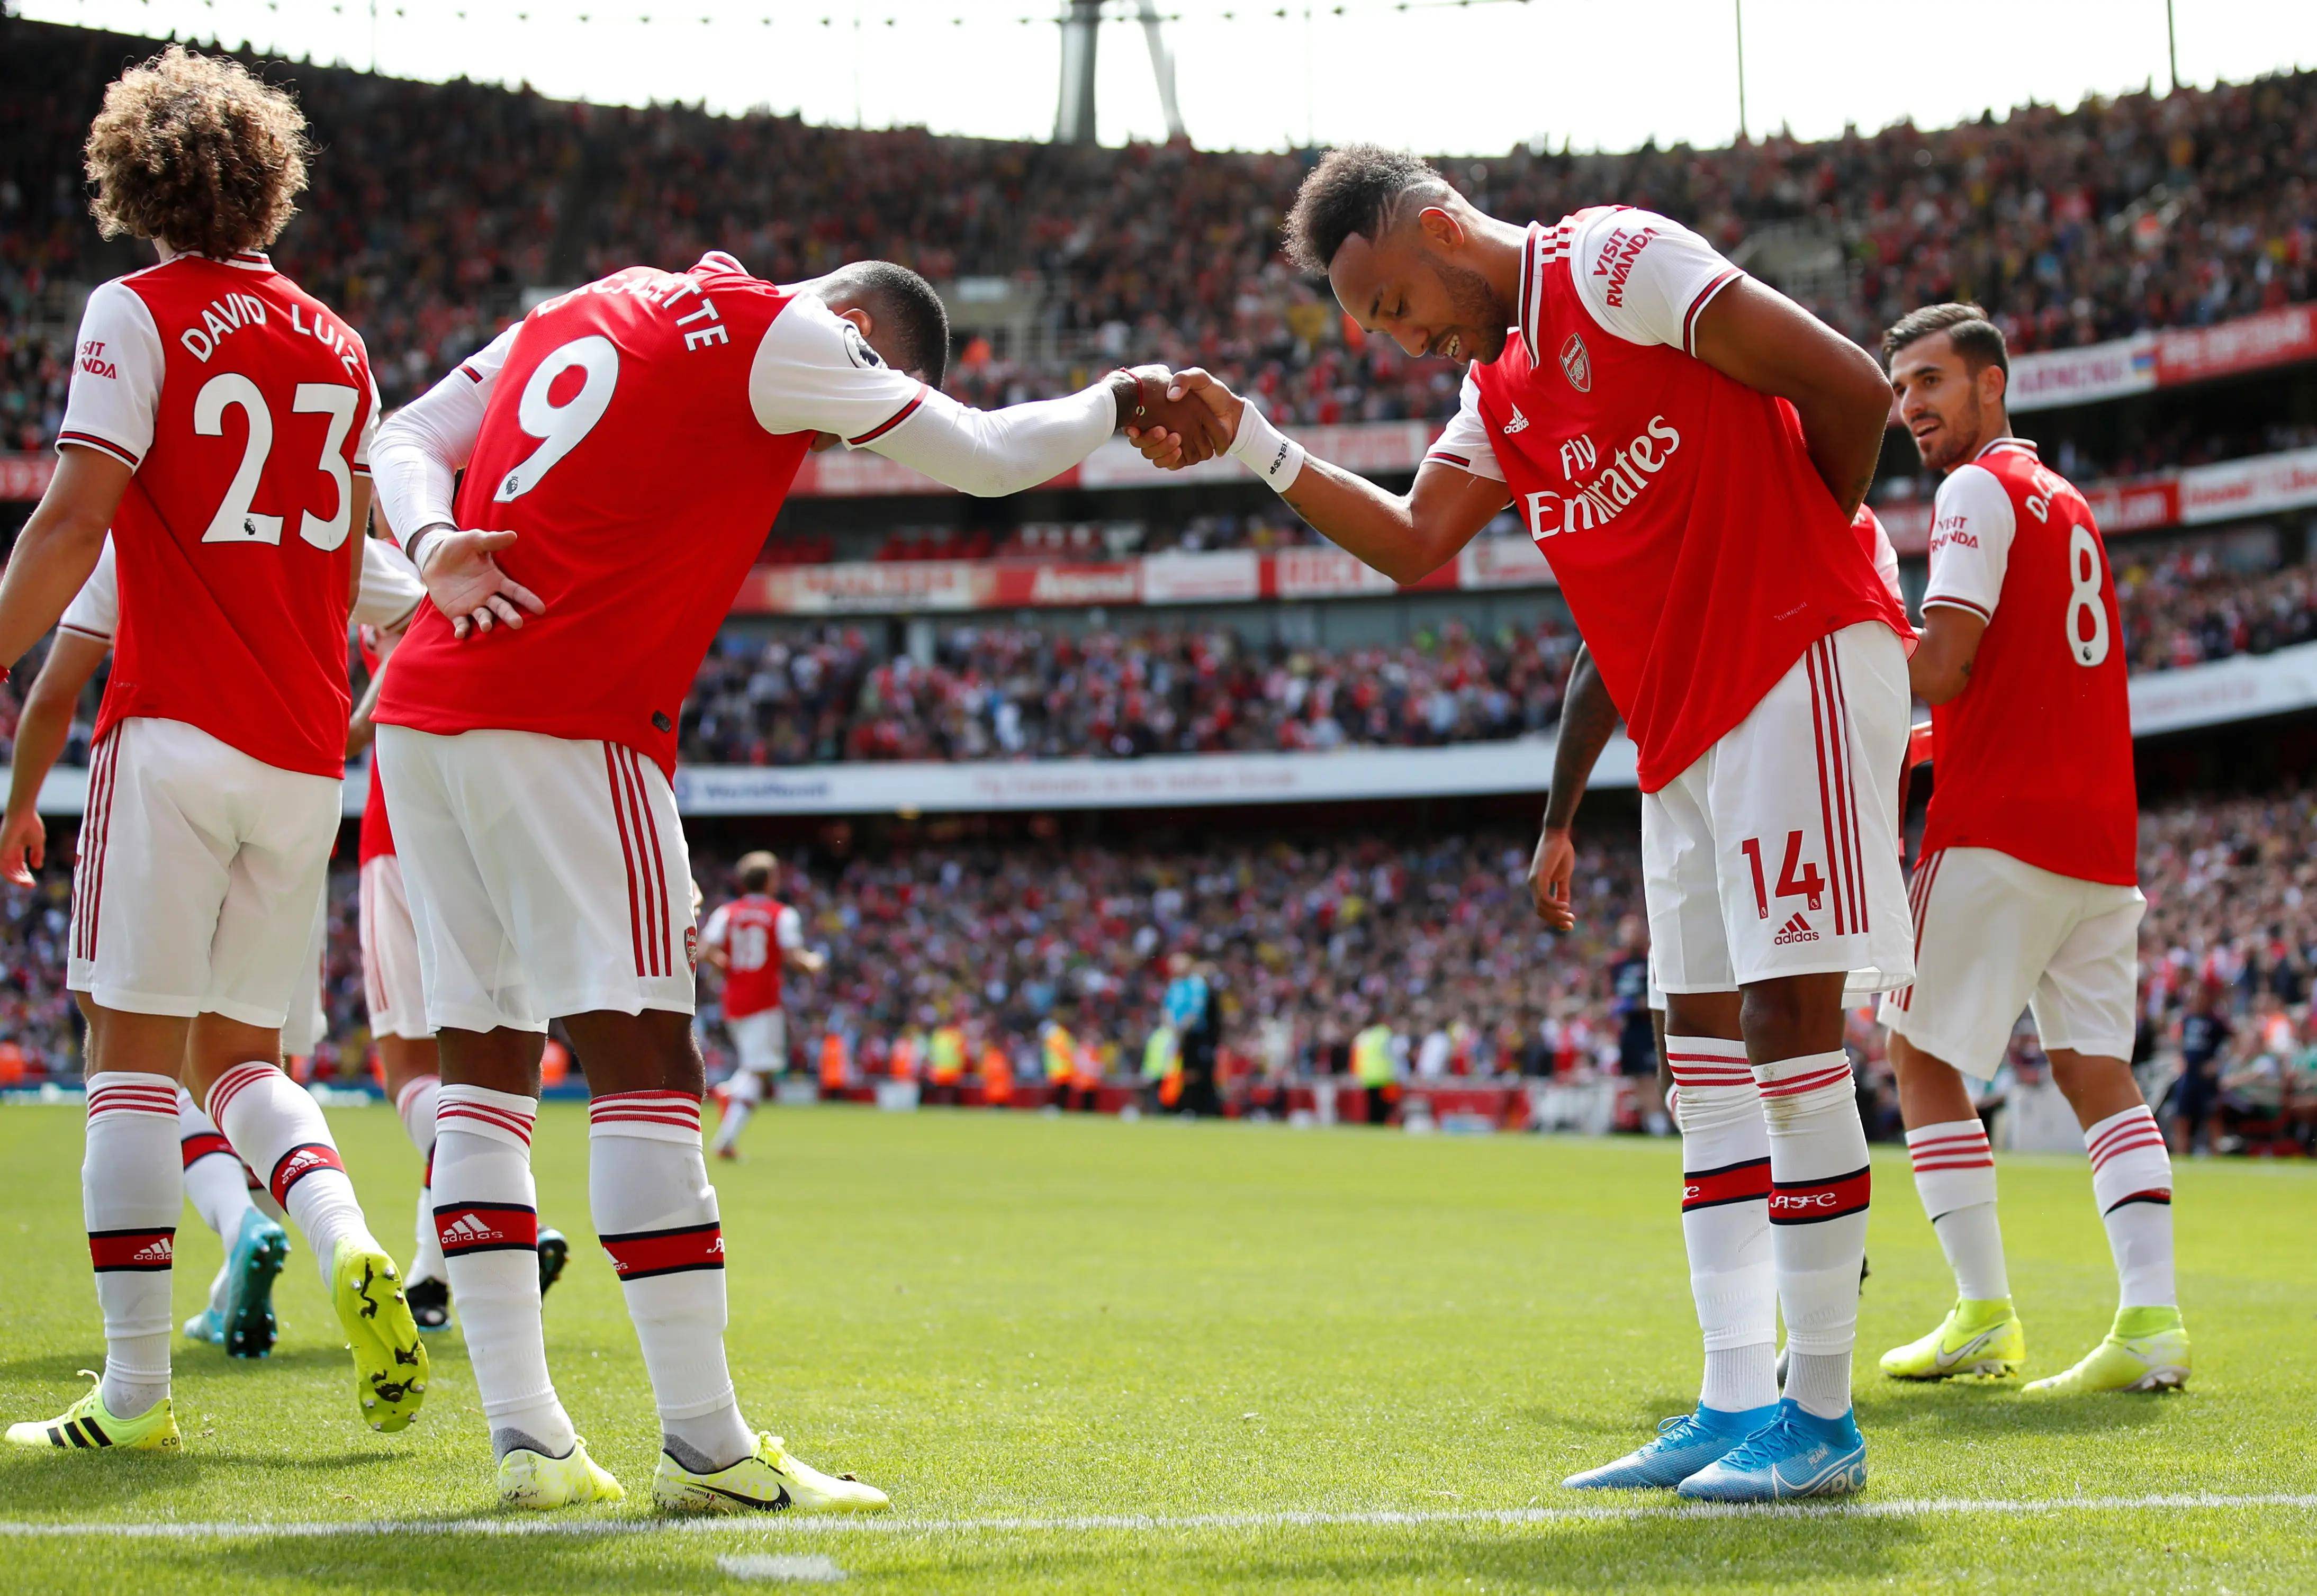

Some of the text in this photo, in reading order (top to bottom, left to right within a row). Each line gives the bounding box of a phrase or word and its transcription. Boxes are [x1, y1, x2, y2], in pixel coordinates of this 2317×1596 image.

[1593, 227, 1626, 276] VISIT
[1607, 227, 1660, 308] RWANDA
[180, 292, 359, 376] DAVID LUIZ
[1564, 340, 1581, 366] Arsenal
[493, 335, 619, 503] 9
[1504, 417, 1529, 434] adidas
[194, 372, 359, 553] 23
[1525, 414, 1680, 542] Emirates
[1559, 432, 1597, 481] Fly
[2066, 524, 2110, 668] 8
[1742, 829, 1825, 919] 14
[1774, 929, 1819, 945] adidas
[282, 1158, 329, 1185] adidas
[134, 1251, 174, 1260] adida
[441, 1229, 504, 1244] adidas
